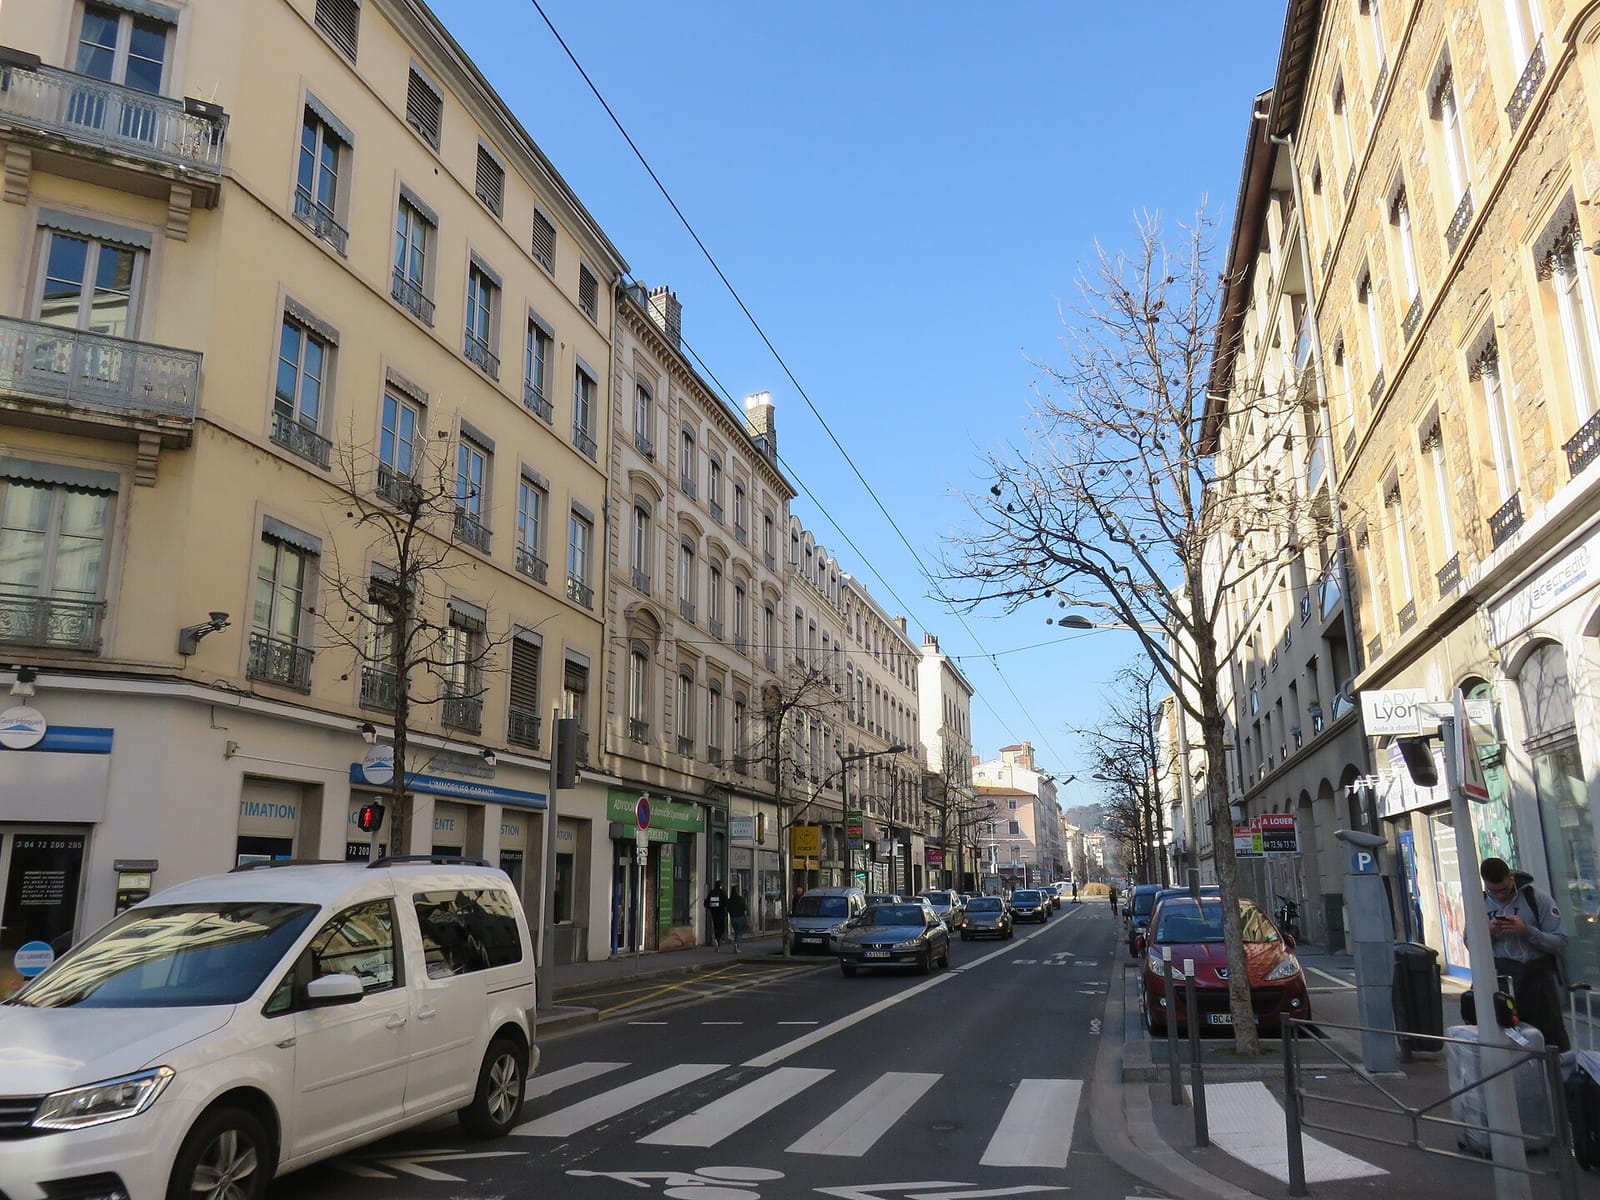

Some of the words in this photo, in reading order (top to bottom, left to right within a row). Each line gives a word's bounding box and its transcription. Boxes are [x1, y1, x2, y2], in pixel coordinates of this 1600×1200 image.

[1383, 692, 1415, 706] ADV
[1270, 817, 1293, 825] LOUER
[349, 845, 356, 856] 72
[1358, 851, 1372, 872] P
